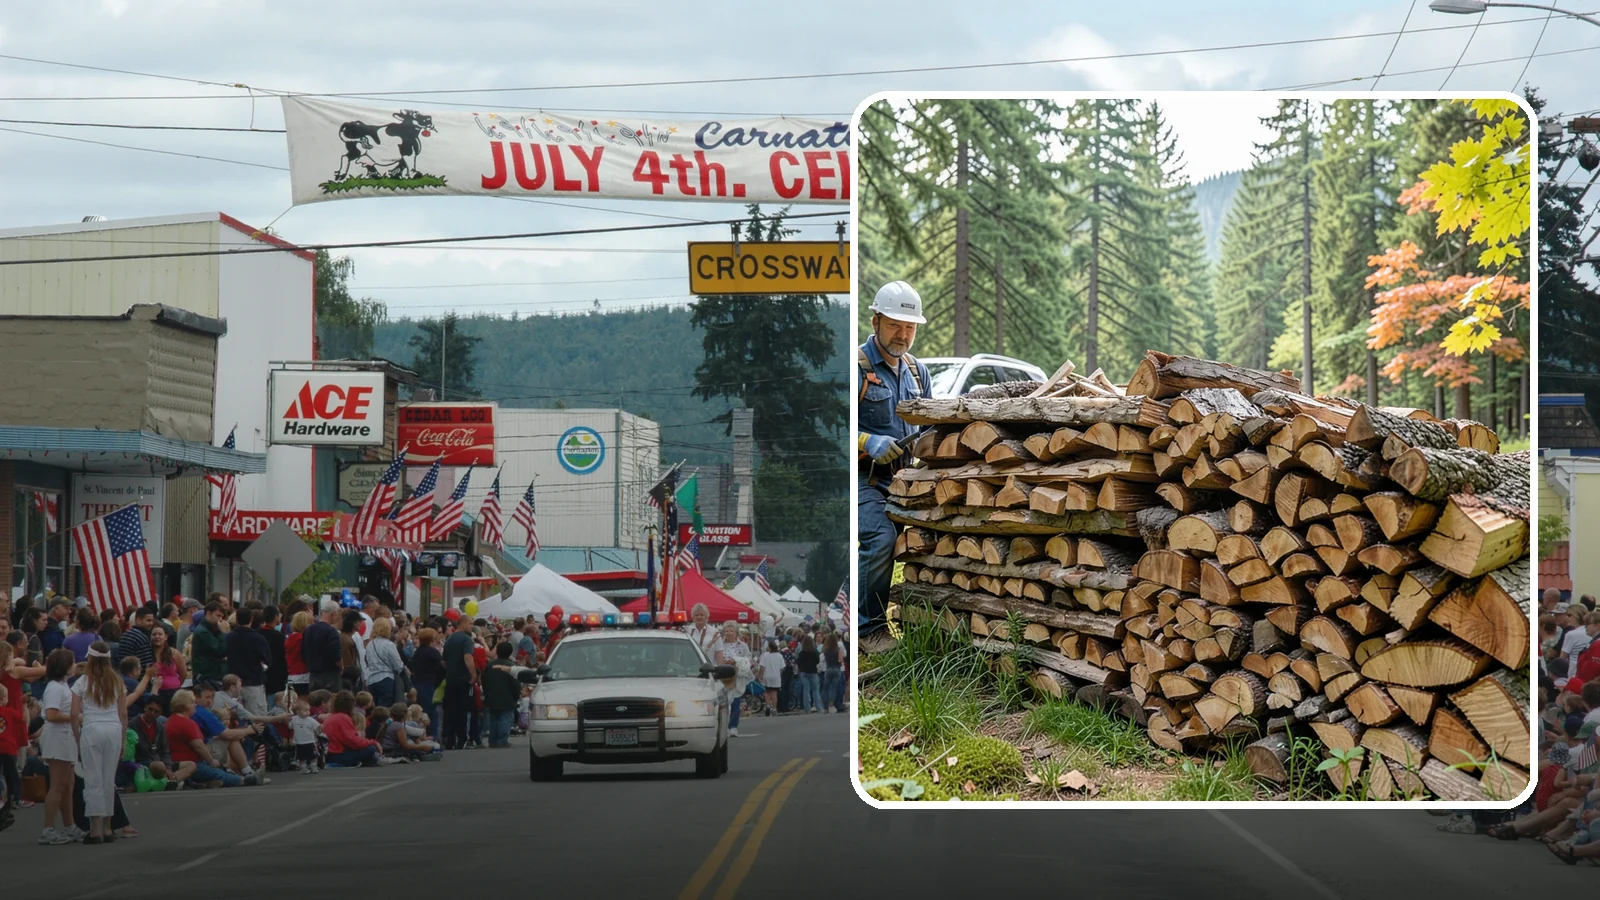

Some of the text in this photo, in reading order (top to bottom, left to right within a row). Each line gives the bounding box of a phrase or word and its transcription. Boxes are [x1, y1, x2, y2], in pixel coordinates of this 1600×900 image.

[481, 141, 605, 193] JULY
[632, 150, 746, 198] 4th.
[696, 254, 850, 280] CROSSWA
[282, 380, 373, 420] ACE
[406, 409, 452, 422] CEDAR
[283, 421, 370, 436] Hardware
[416, 428, 477, 447] Coca-Cola
[83, 484, 155, 495] St. Vincent de Paul
[688, 526, 741, 535] CRNATION
[699, 535, 730, 543] GLASS
